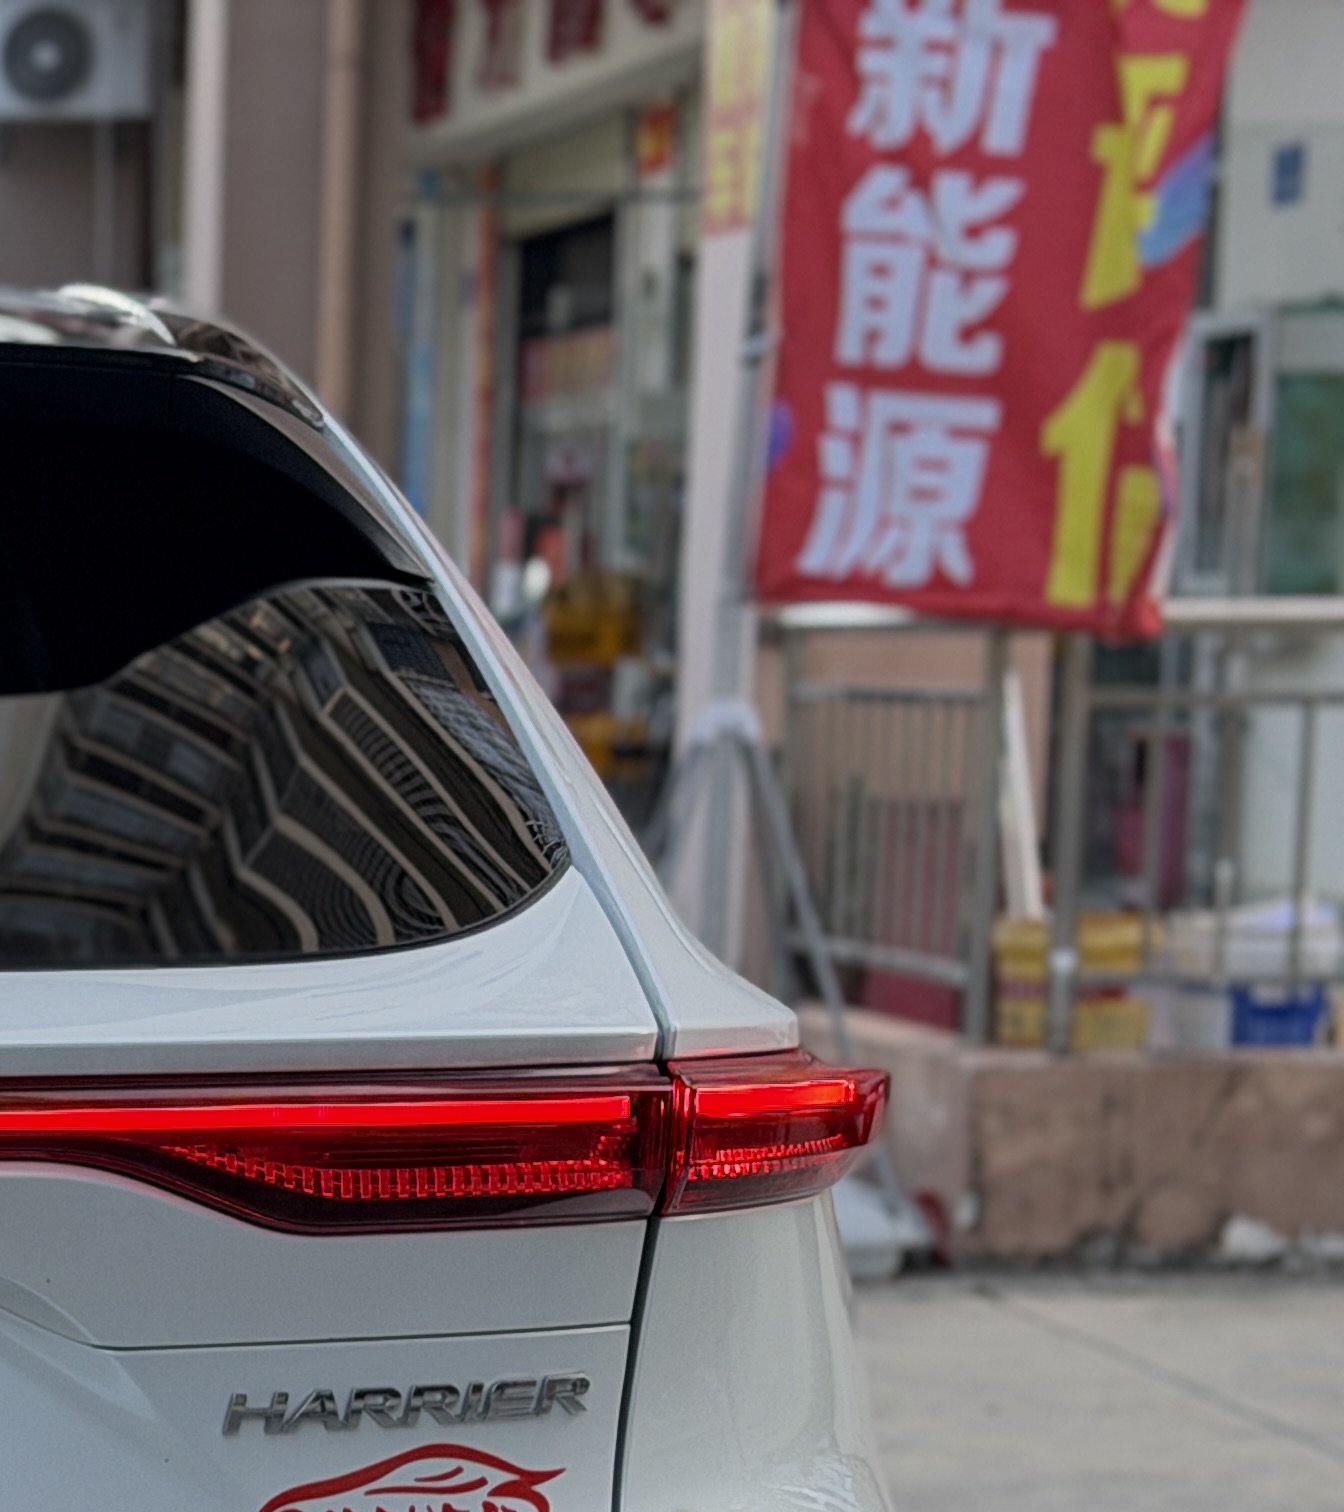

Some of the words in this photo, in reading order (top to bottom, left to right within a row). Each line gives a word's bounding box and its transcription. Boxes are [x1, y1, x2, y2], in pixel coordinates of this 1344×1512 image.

[798, 0, 1056, 587] 新能源
[221, 1371, 591, 1435] HARRIER
